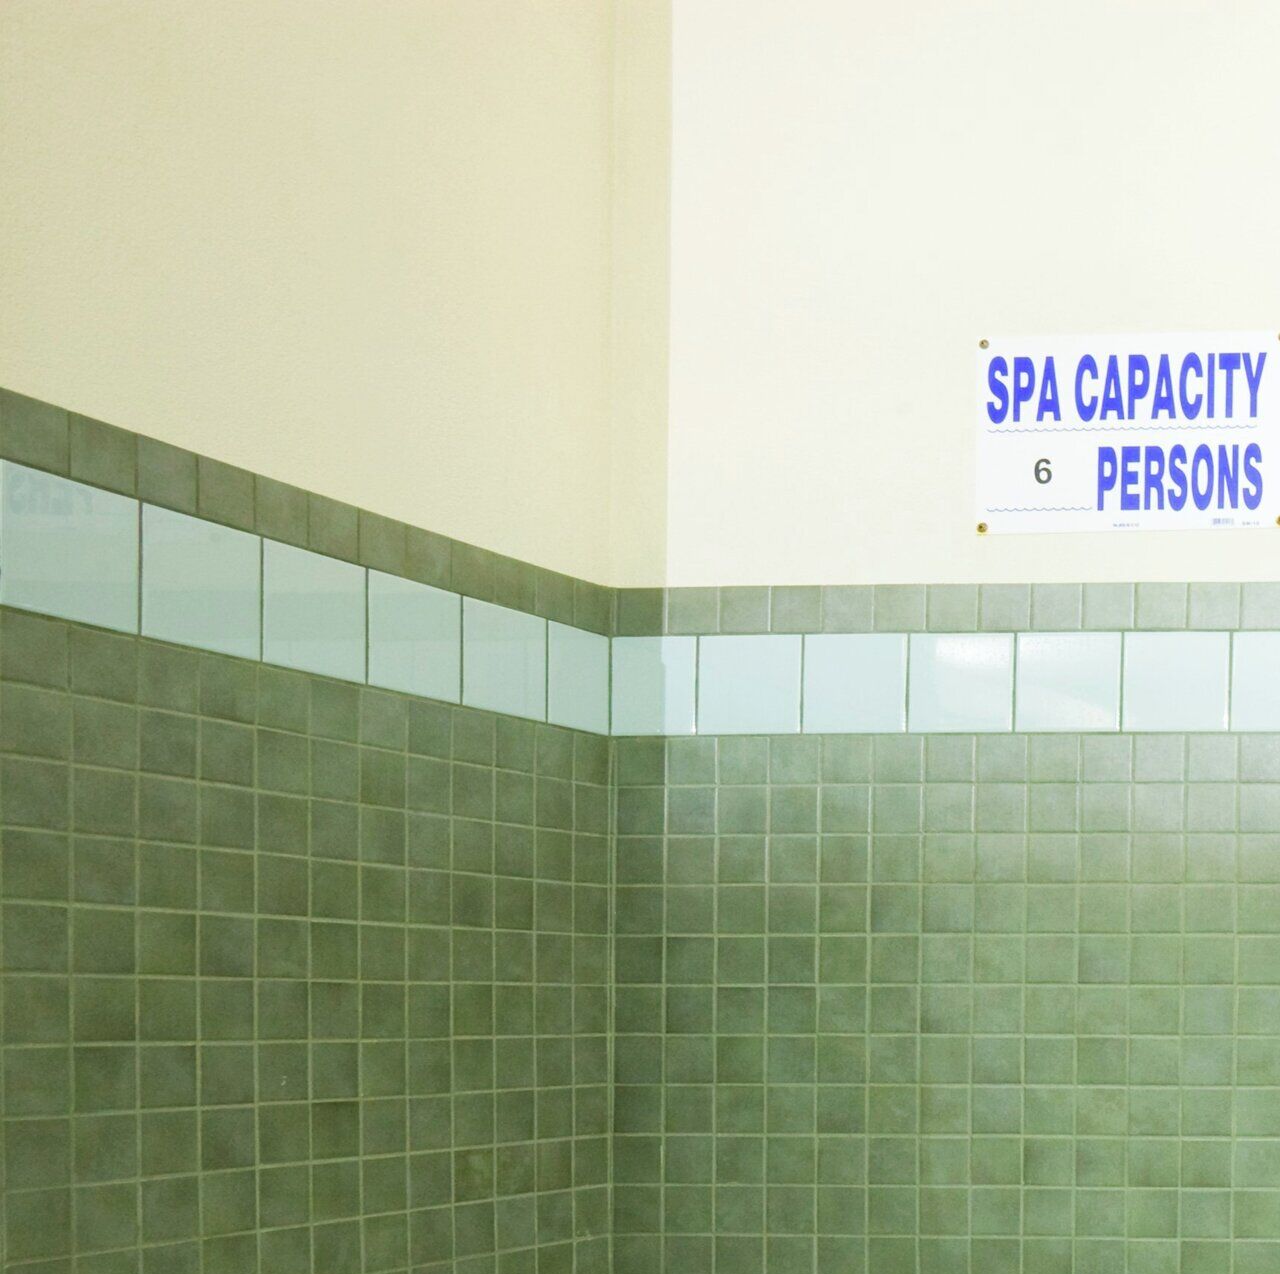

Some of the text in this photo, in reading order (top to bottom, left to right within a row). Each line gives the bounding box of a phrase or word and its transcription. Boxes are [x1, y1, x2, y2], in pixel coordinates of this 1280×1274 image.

[986, 352, 1267, 424] SPA CAPACITY
[1033, 443, 1263, 511] 6 PERSONS
